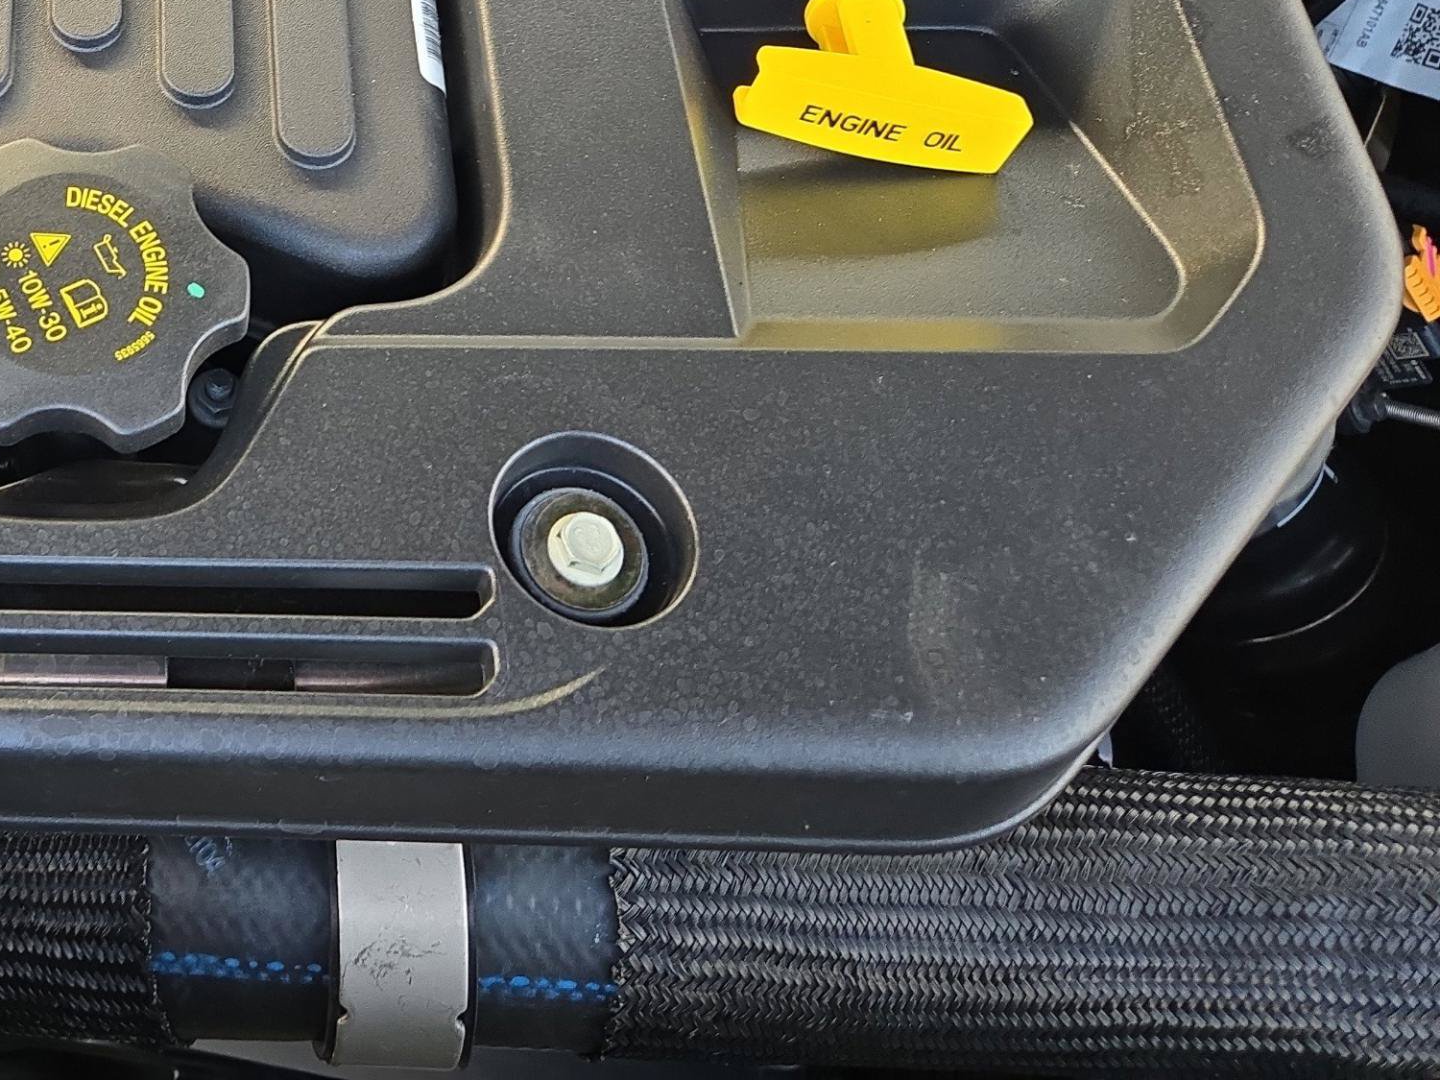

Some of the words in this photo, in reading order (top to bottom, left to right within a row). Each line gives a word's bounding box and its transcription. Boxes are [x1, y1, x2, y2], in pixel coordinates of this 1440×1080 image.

[799, 104, 907, 142] ENGINE
[923, 131, 962, 152] OIL
[66, 185, 135, 228] DIESEL
[129, 220, 169, 295] ENGINE
[18, 270, 67, 342] 10W-30
[127, 295, 163, 327] OIL
